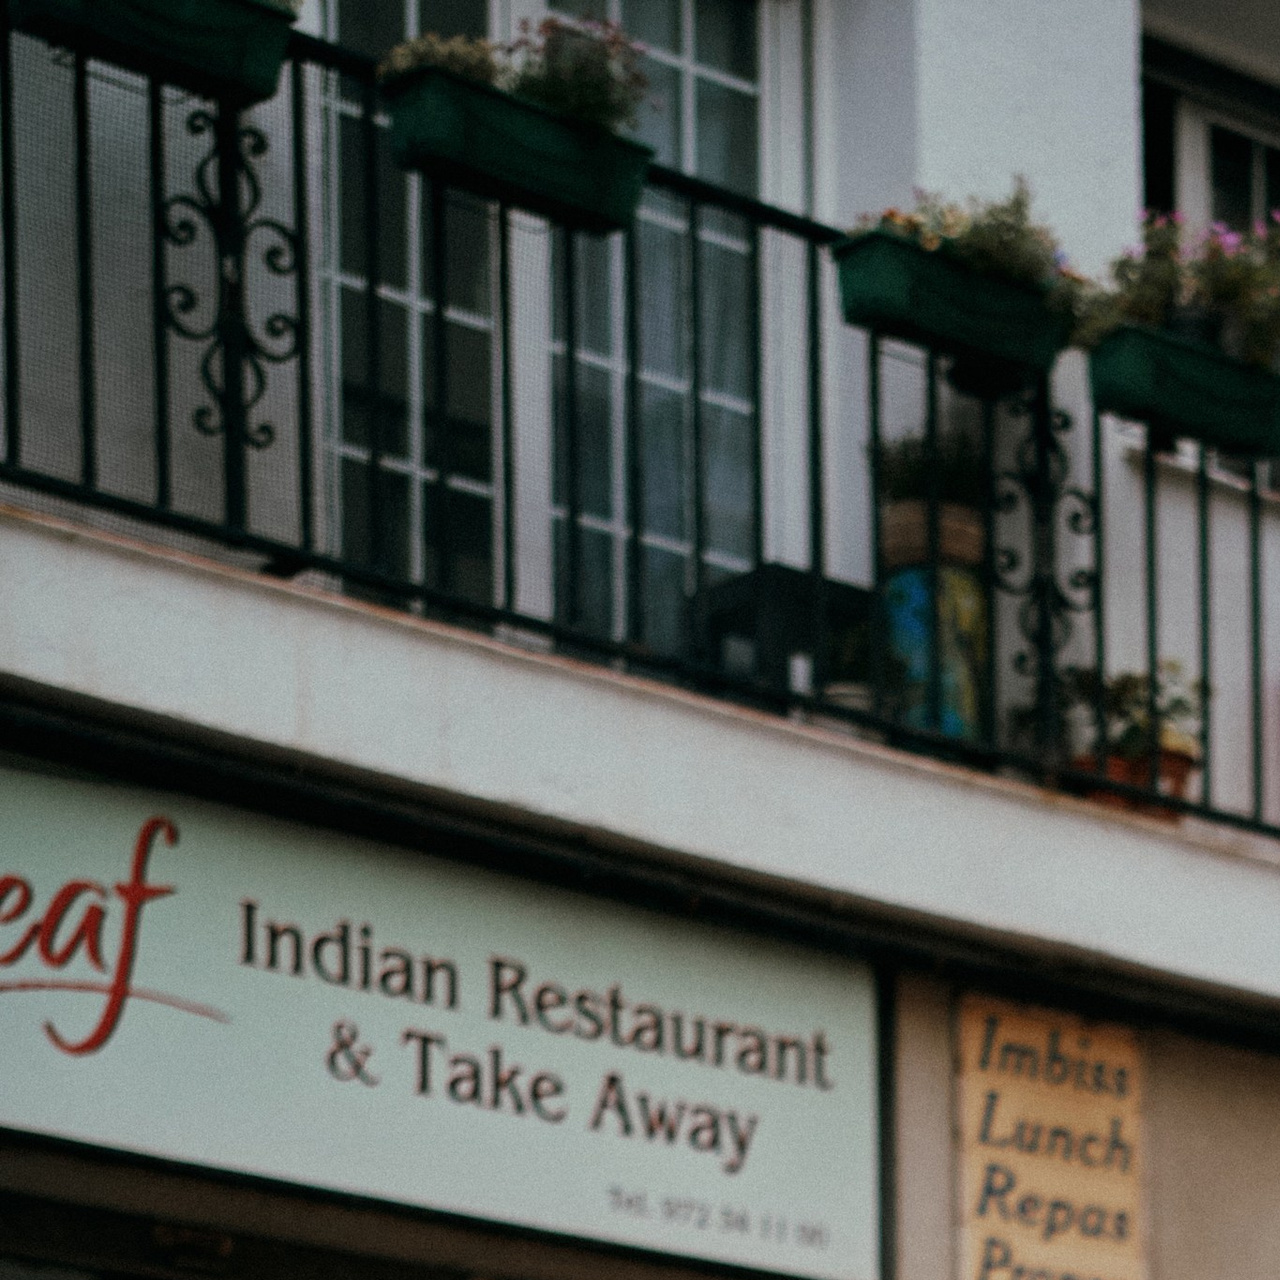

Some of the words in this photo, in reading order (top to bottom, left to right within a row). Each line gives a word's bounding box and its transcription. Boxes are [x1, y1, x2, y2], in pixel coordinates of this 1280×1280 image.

[239, 898, 459, 1011] Indian
[486, 954, 835, 1092] Restaurant
[325, 1019, 379, 1087] &
[401, 1027, 567, 1124] Take
[589, 1071, 759, 1175] Away
[977, 1090, 1133, 1175] Lunch
[976, 1162, 1130, 1243] Repas
